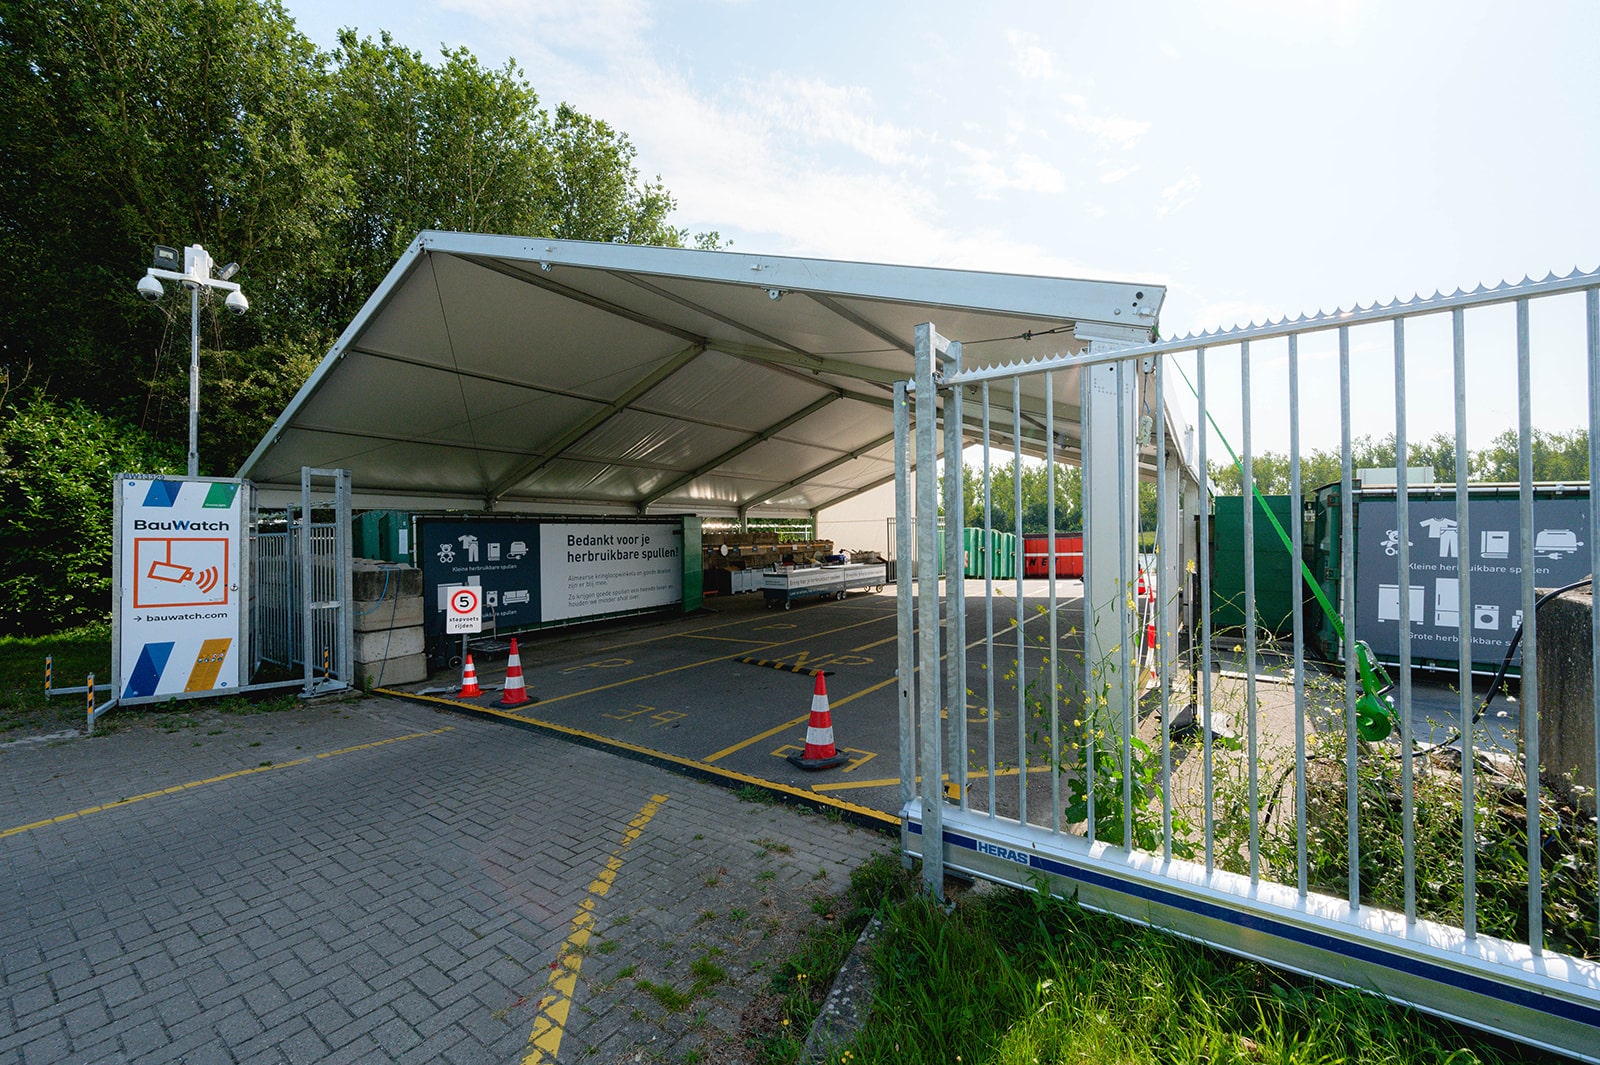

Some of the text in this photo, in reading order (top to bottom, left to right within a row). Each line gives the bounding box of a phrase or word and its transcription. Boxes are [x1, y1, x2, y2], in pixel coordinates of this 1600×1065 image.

[134, 520, 229, 531] BauWatch
[567, 533, 650, 547] Bedankt voor je
[567, 547, 679, 563] herbruikbare spullen!
[1408, 562, 1550, 575] Kleine heruikbare spen
[459, 596, 469, 607] 5
[146, 611, 228, 622] bauwatch.com
[1408, 631, 1434, 641] Grote
[1435, 634, 1502, 646] herbikbare
[978, 841, 1028, 865] HERAS
